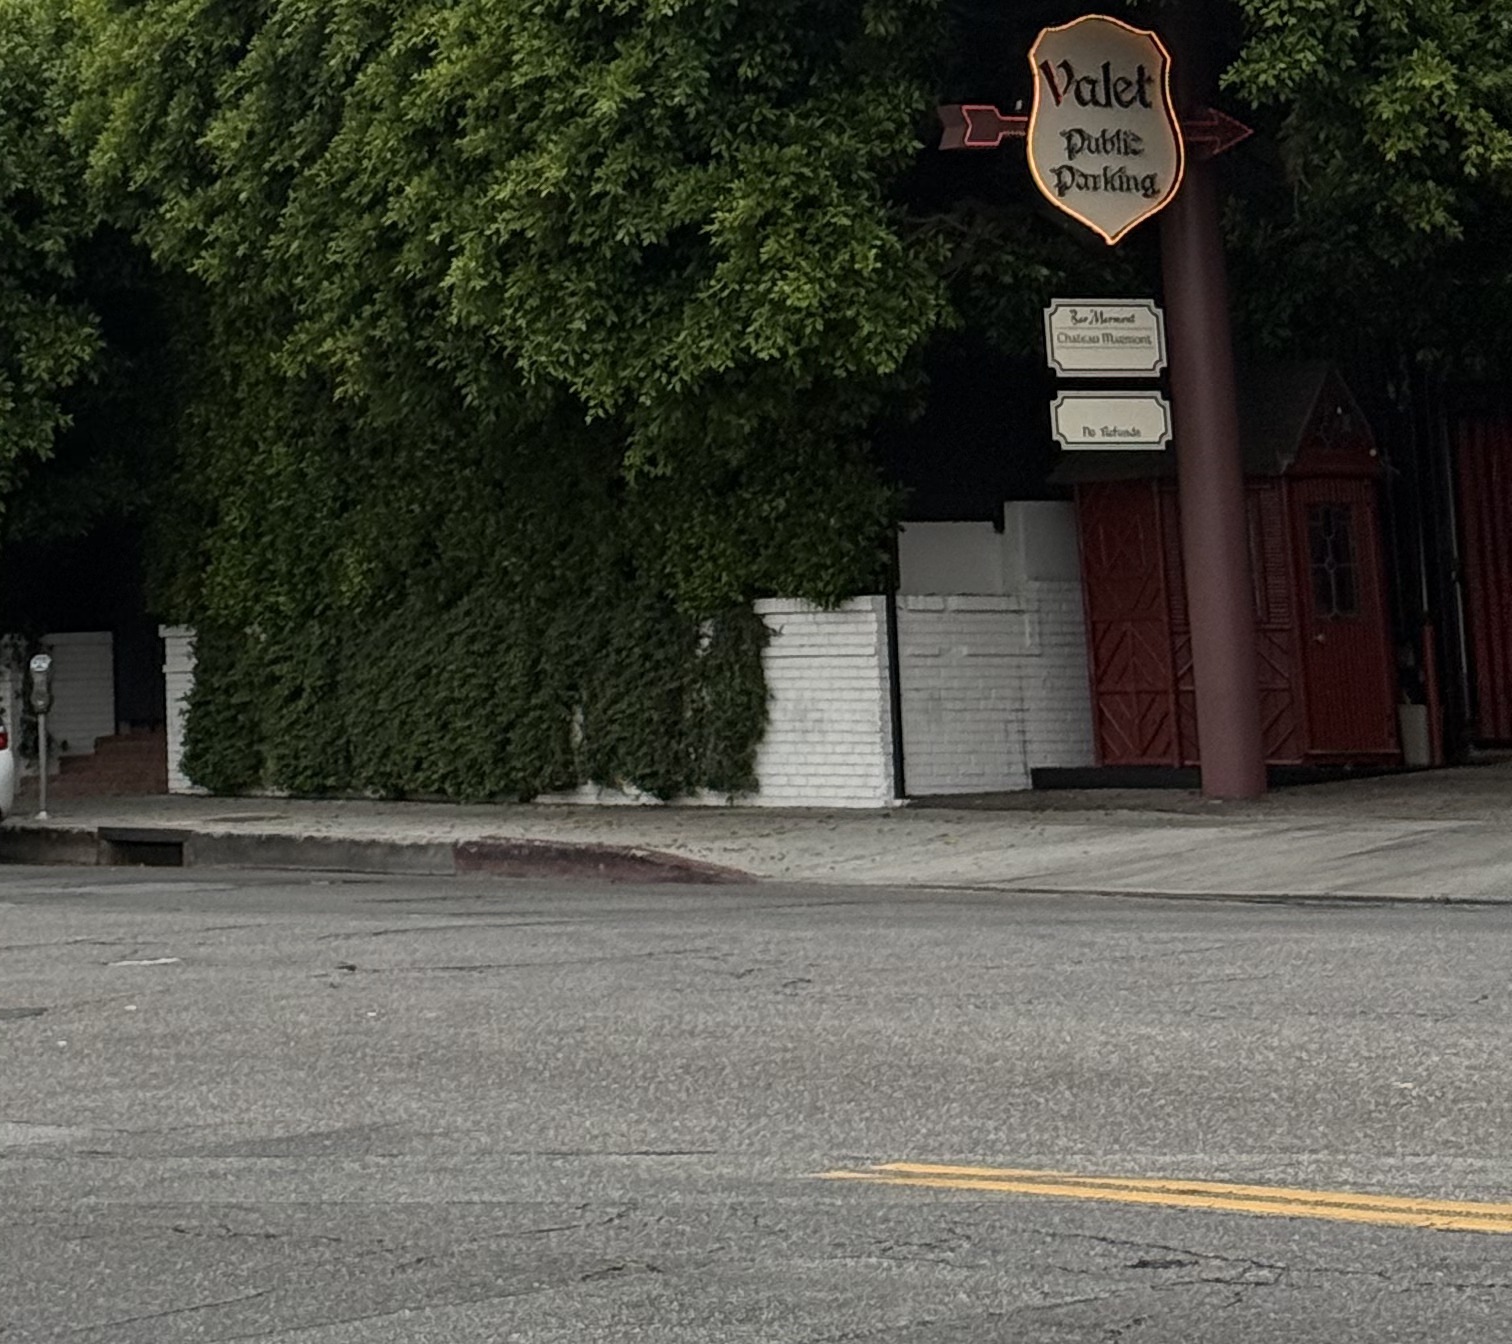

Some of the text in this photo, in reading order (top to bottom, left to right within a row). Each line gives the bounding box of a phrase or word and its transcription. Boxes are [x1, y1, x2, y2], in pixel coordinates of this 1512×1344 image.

[1039, 59, 1154, 109] Valet
[1060, 127, 1145, 161] Public
[1050, 163, 1160, 199] Parking
